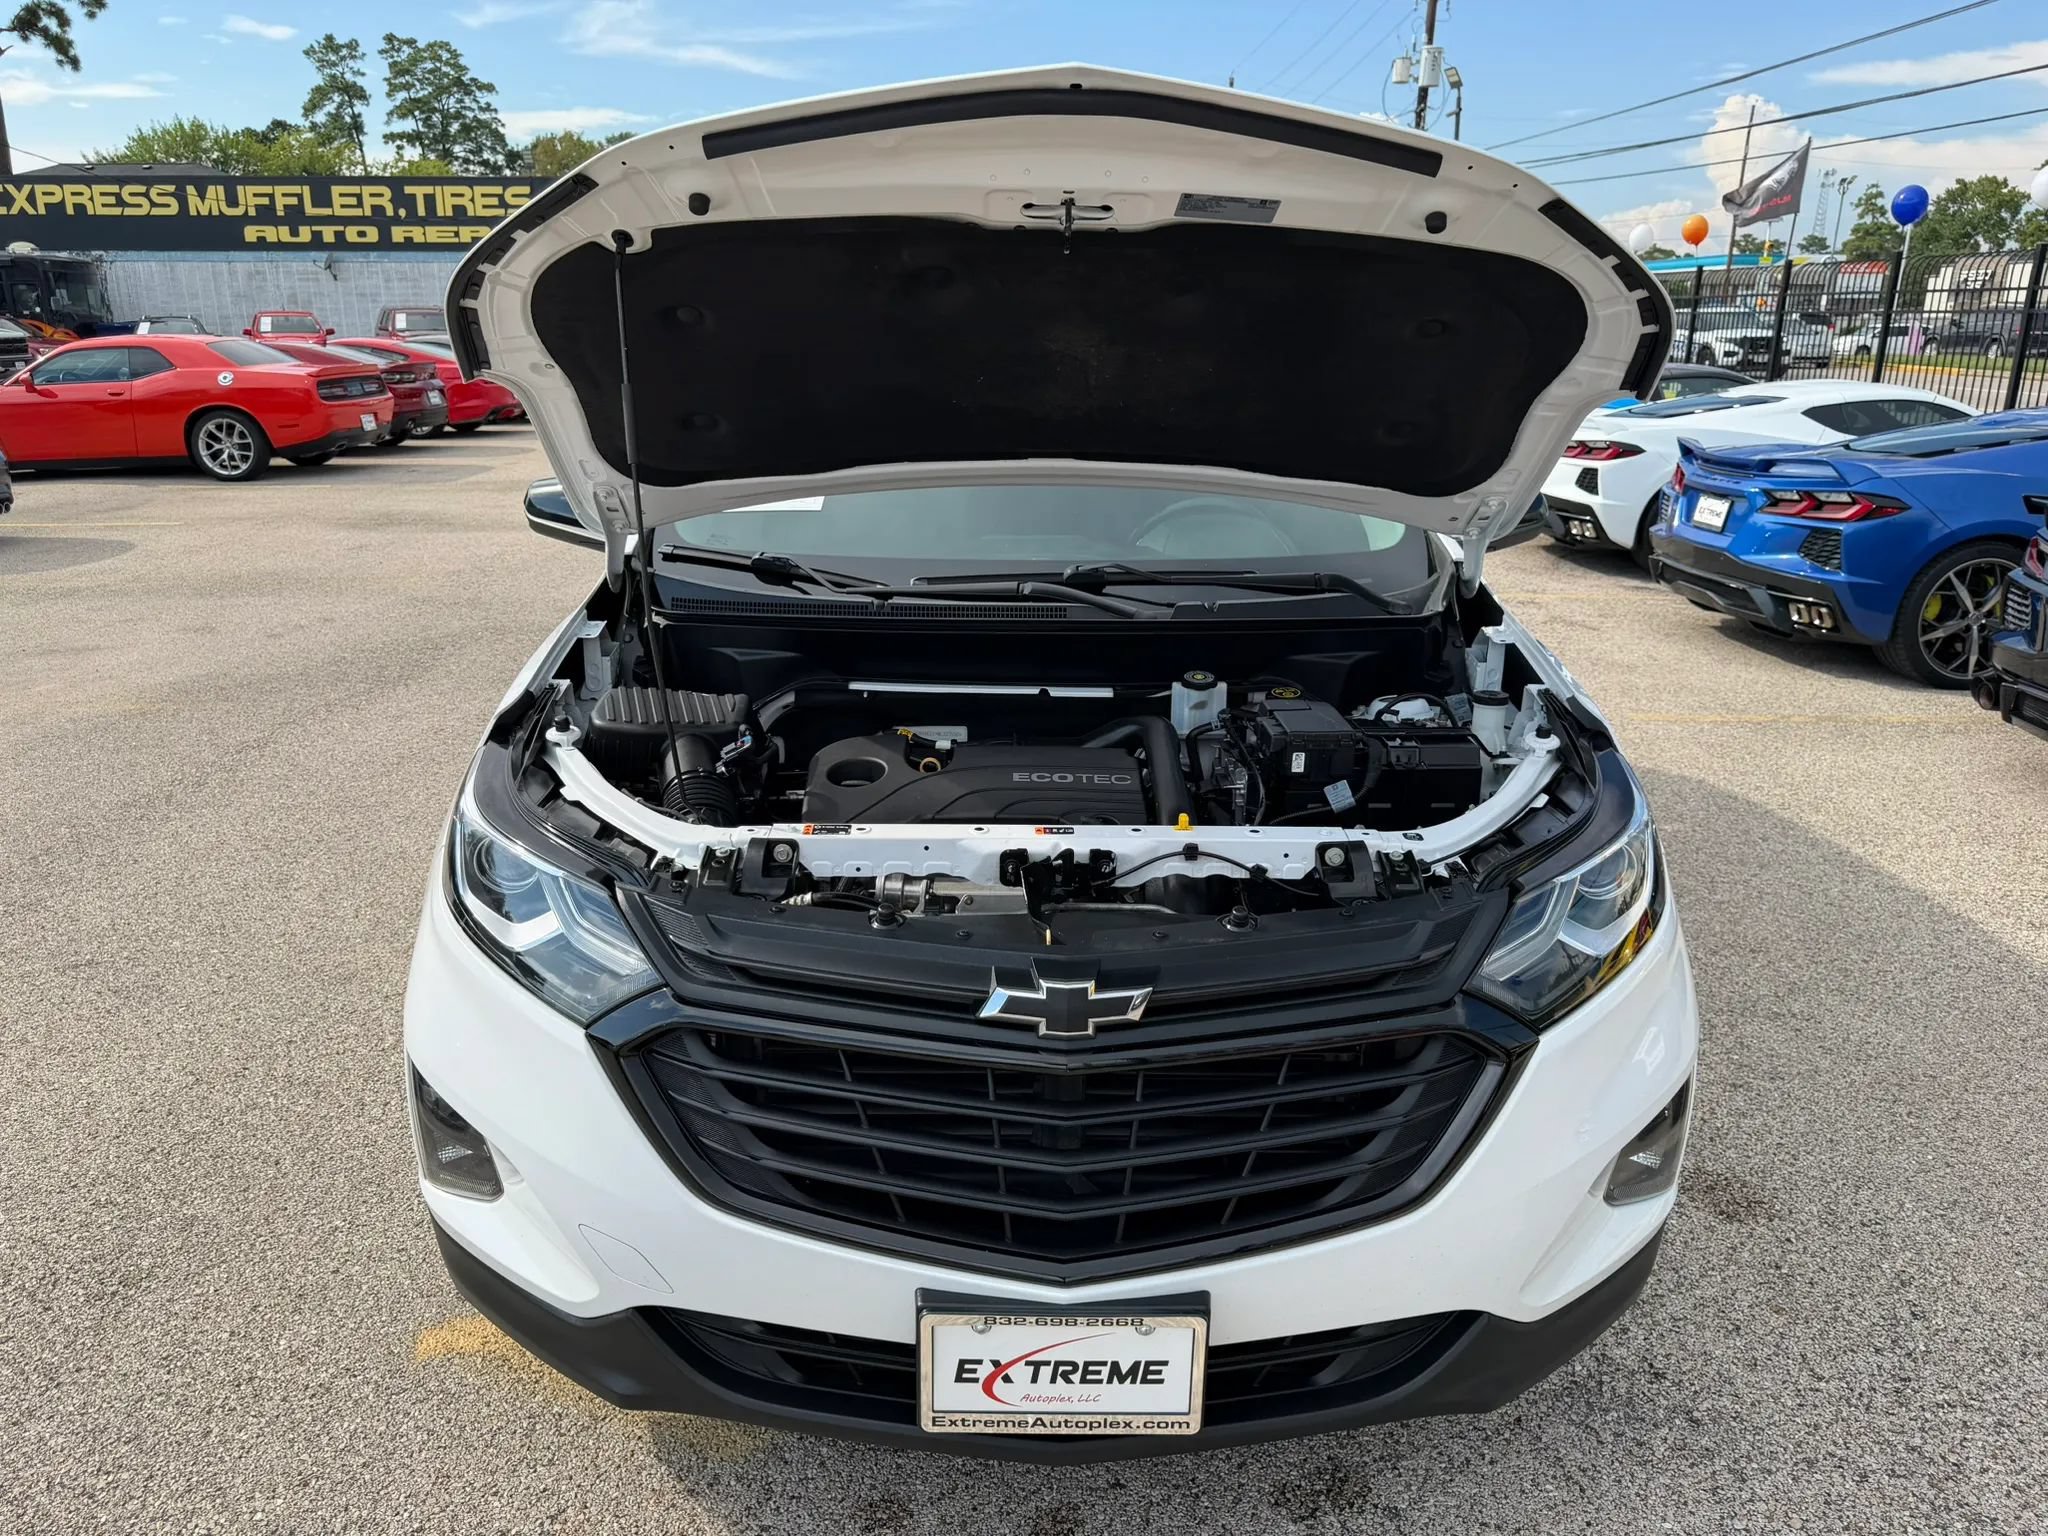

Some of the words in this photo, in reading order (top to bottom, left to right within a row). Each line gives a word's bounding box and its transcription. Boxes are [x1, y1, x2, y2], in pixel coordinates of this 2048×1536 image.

[0, 184, 179, 216] XPRESS
[244, 225, 379, 243] AUTO
[1012, 772, 1132, 785] ECOTEC
[983, 1316, 1145, 1328] 832-698-2668
[954, 1358, 1170, 1385] EXTREME
[1020, 1392, 1074, 1405] Autoplex,
[1077, 1393, 1103, 1404] LLC
[931, 1415, 1192, 1432] ExtremeAutoplex.com
